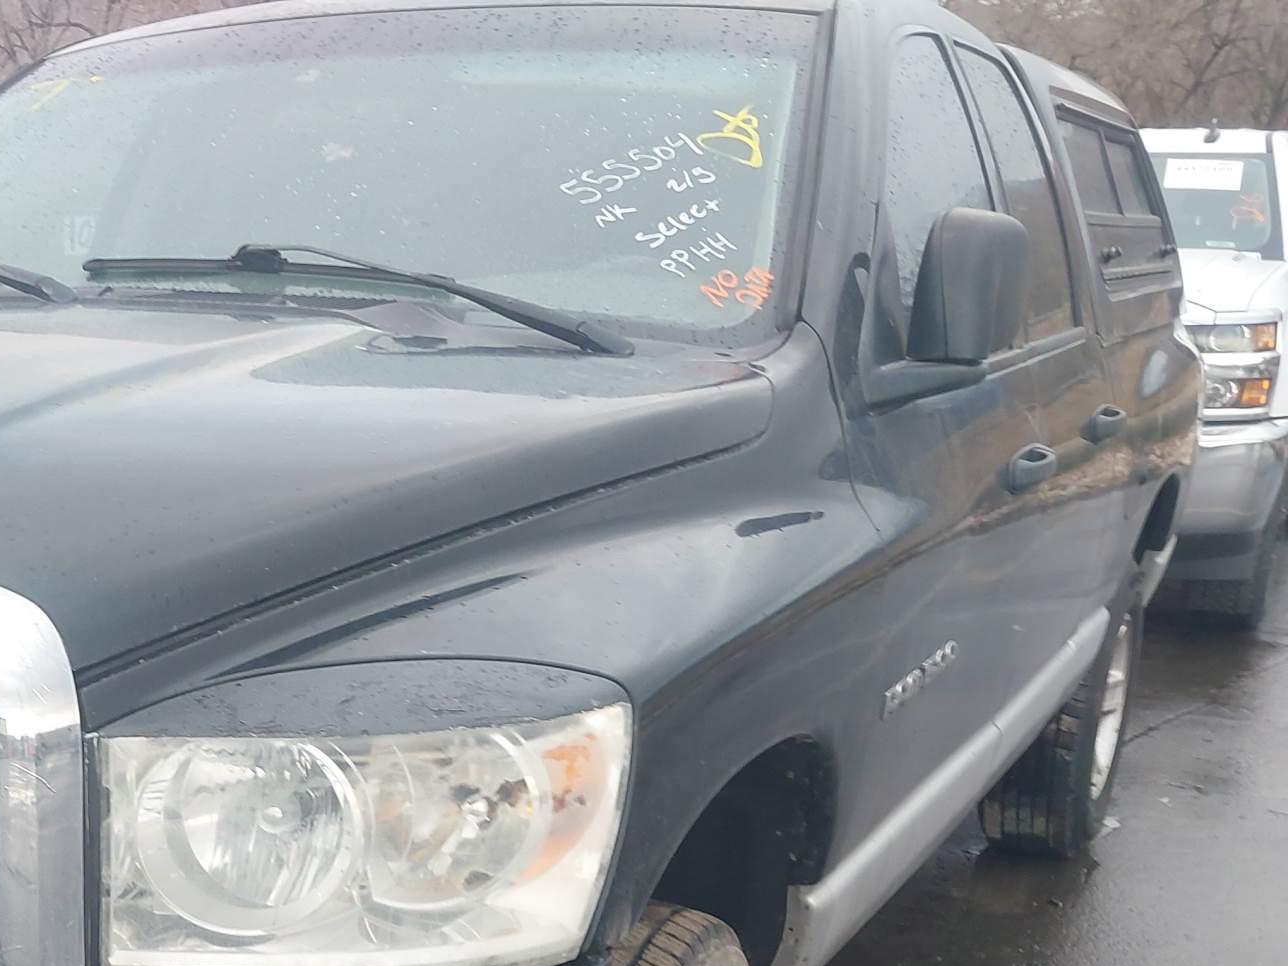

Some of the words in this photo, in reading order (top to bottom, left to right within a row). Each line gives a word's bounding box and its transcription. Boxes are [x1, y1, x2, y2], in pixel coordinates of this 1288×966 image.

[559, 132, 704, 205] 555504
[594, 203, 639, 229] NK
[699, 268, 738, 308] NO
